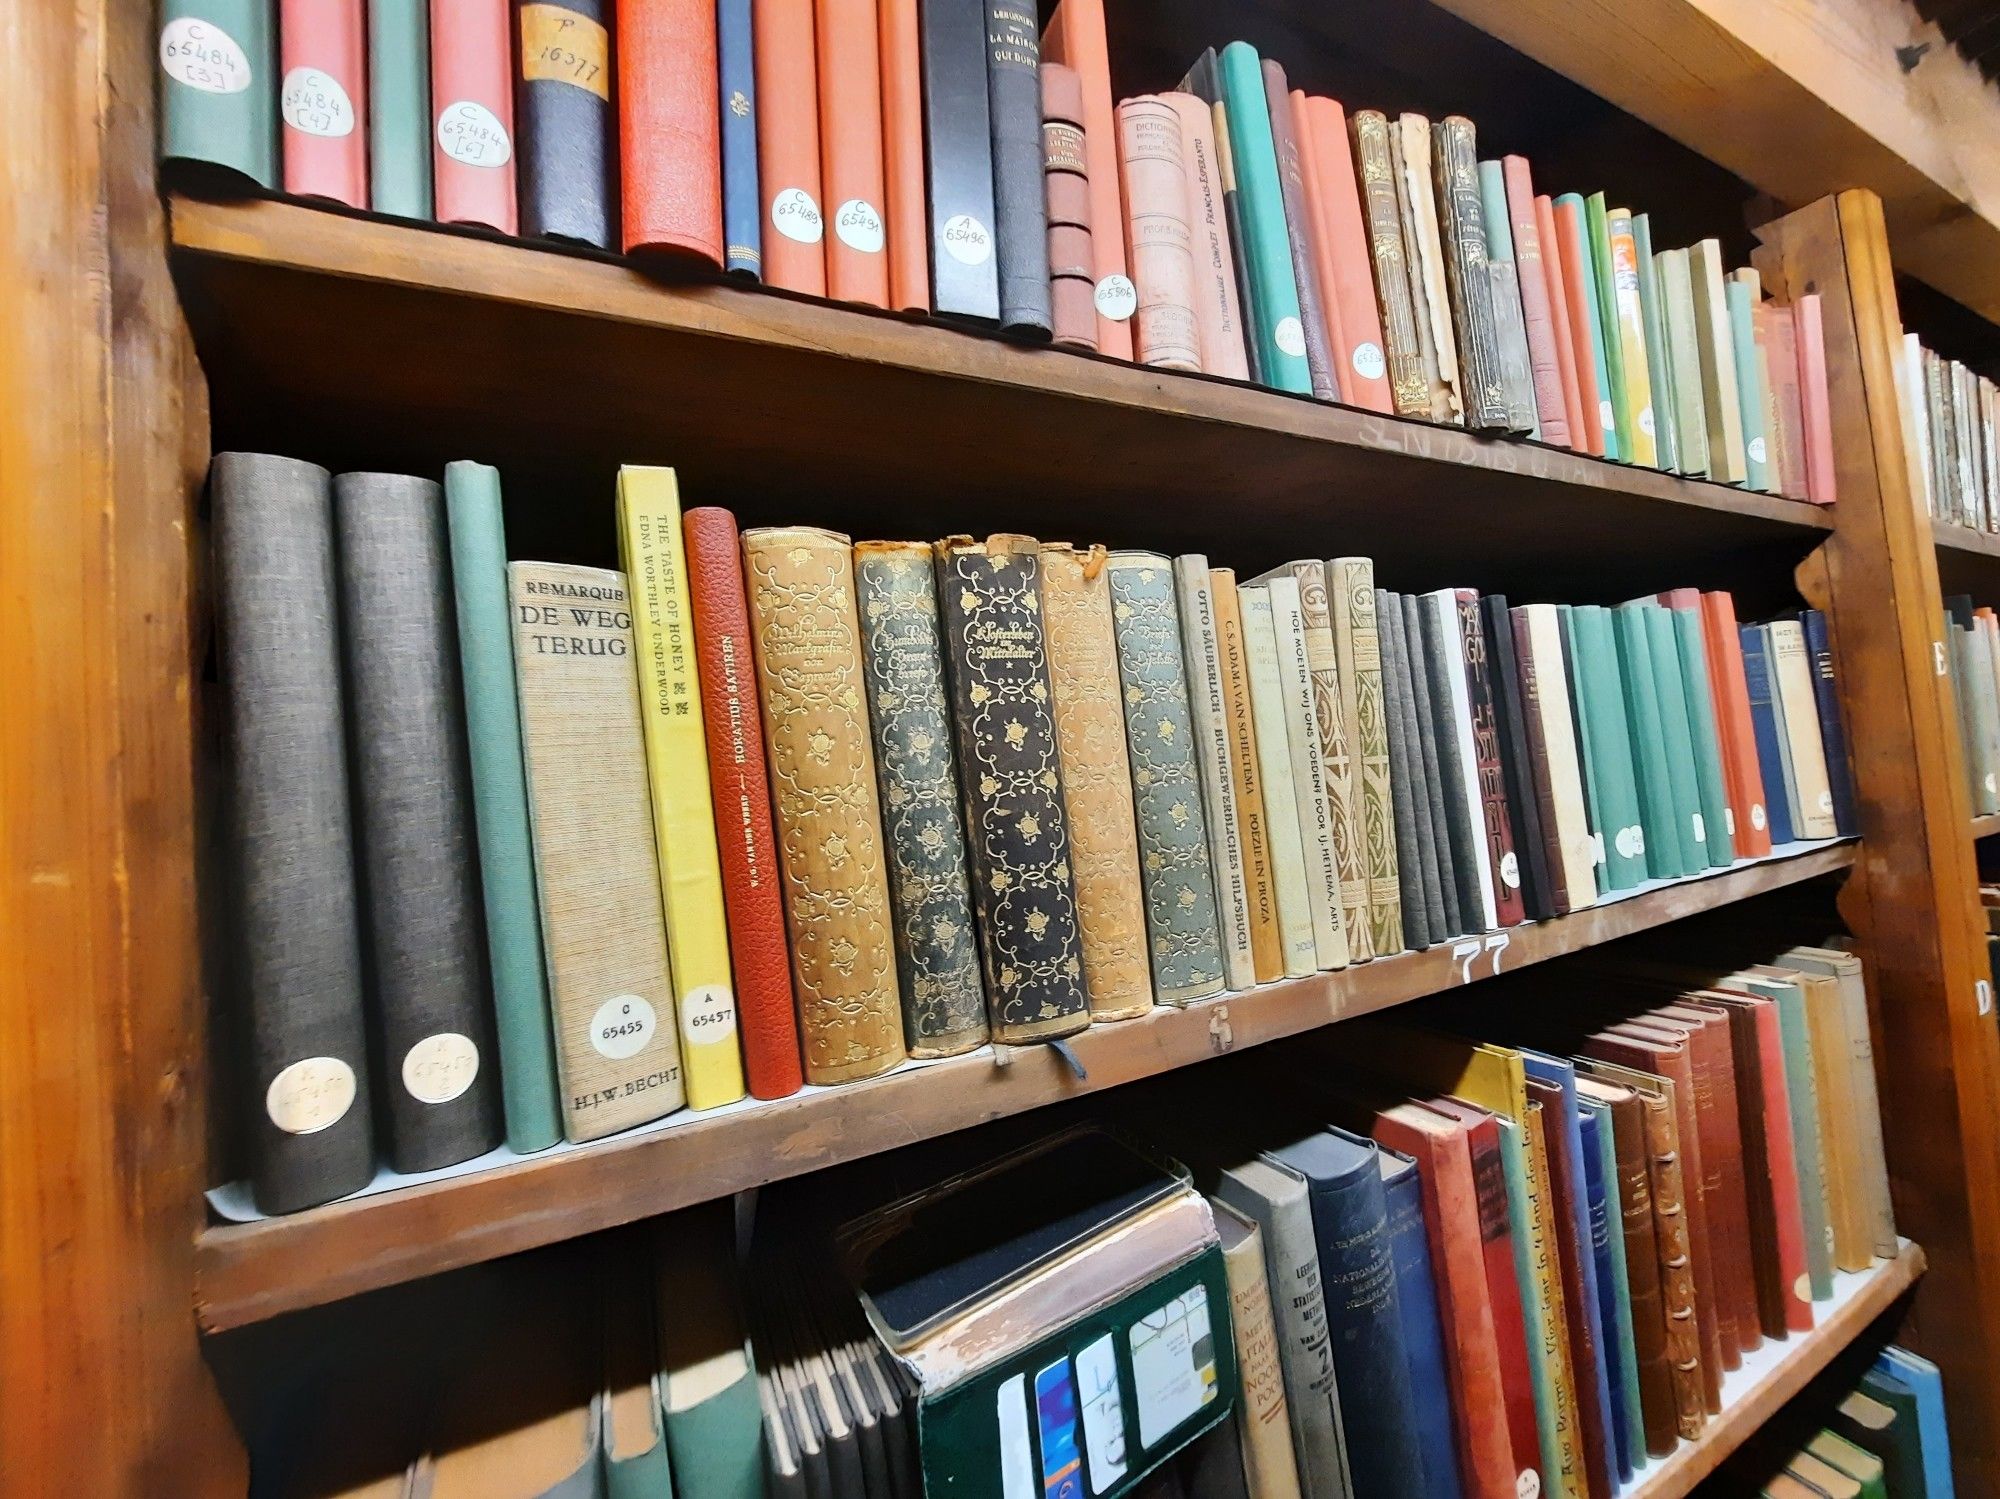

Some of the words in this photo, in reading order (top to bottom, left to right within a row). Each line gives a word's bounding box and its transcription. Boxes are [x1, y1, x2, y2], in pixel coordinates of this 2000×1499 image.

[187, 25, 205, 40] C
[990, 34, 1002, 44] LA
[166, 41, 236, 72] 65484
[540, 45, 600, 80] 16377
[995, 51, 1012, 61] QUI
[306, 75, 319, 87] C
[458, 106, 478, 120] C
[443, 119, 504, 145] 65484
[796, 191, 804, 203] C
[856, 201, 866, 214] C
[959, 217, 971, 229] A
[946, 228, 985, 245] 65496
[1213, 231, 1223, 268] COMPLET
[1111, 277, 1120, 286] C
[639, 514, 651, 550] EDNA
[657, 515, 671, 545] THE
[661, 550, 676, 595] TASTE
[526, 581, 624, 601] REMARQUE
[644, 555, 662, 628] WORTHLEY
[519, 605, 558, 625] DE
[570, 609, 632, 630] WEG
[669, 600, 679, 622] OF
[1197, 590, 1210, 626] OTTO
[1291, 610, 1300, 634] HOE
[532, 634, 628, 656] TERUG
[670, 623, 685, 675] HONEY
[975, 644, 1036, 660] Mittelalter
[720, 634, 741, 694] SATIREN
[1203, 629, 1221, 713] SÄUBERLICH
[1295, 637, 1307, 684] MOETEN
[656, 632, 671, 716] UNDERWOOD
[1235, 691, 1245, 720] VAN
[1301, 687, 1313, 708] WIJ
[727, 698, 747, 764] HORATIUS
[1304, 713, 1313, 738] ONS
[1236, 722, 1254, 795] SCHELTEMA
[1214, 728, 1238, 871] BUCHGEWERBLICHES
[1315, 797, 1326, 830] DOOR
[744, 828, 755, 843] DER
[1249, 813, 1263, 858] POEZIE
[747, 843, 757, 864] VAN
[1255, 859, 1264, 877] EN
[1231, 874, 1247, 951] HILFSBUCH
[1258, 880, 1271, 925] PROZA
[1329, 905, 1339, 932] ARTS
[1452, 932, 1510, 985] 77
[704, 993, 713, 1003] A
[602, 1020, 643, 1040] 65455
[692, 1009, 732, 1028] 65457
[1528, 1193, 1541, 1231] land
[1536, 1252, 1547, 1270] in
[1542, 1278, 1552, 1311] jaar
[1300, 1335, 1314, 1345] VAN
